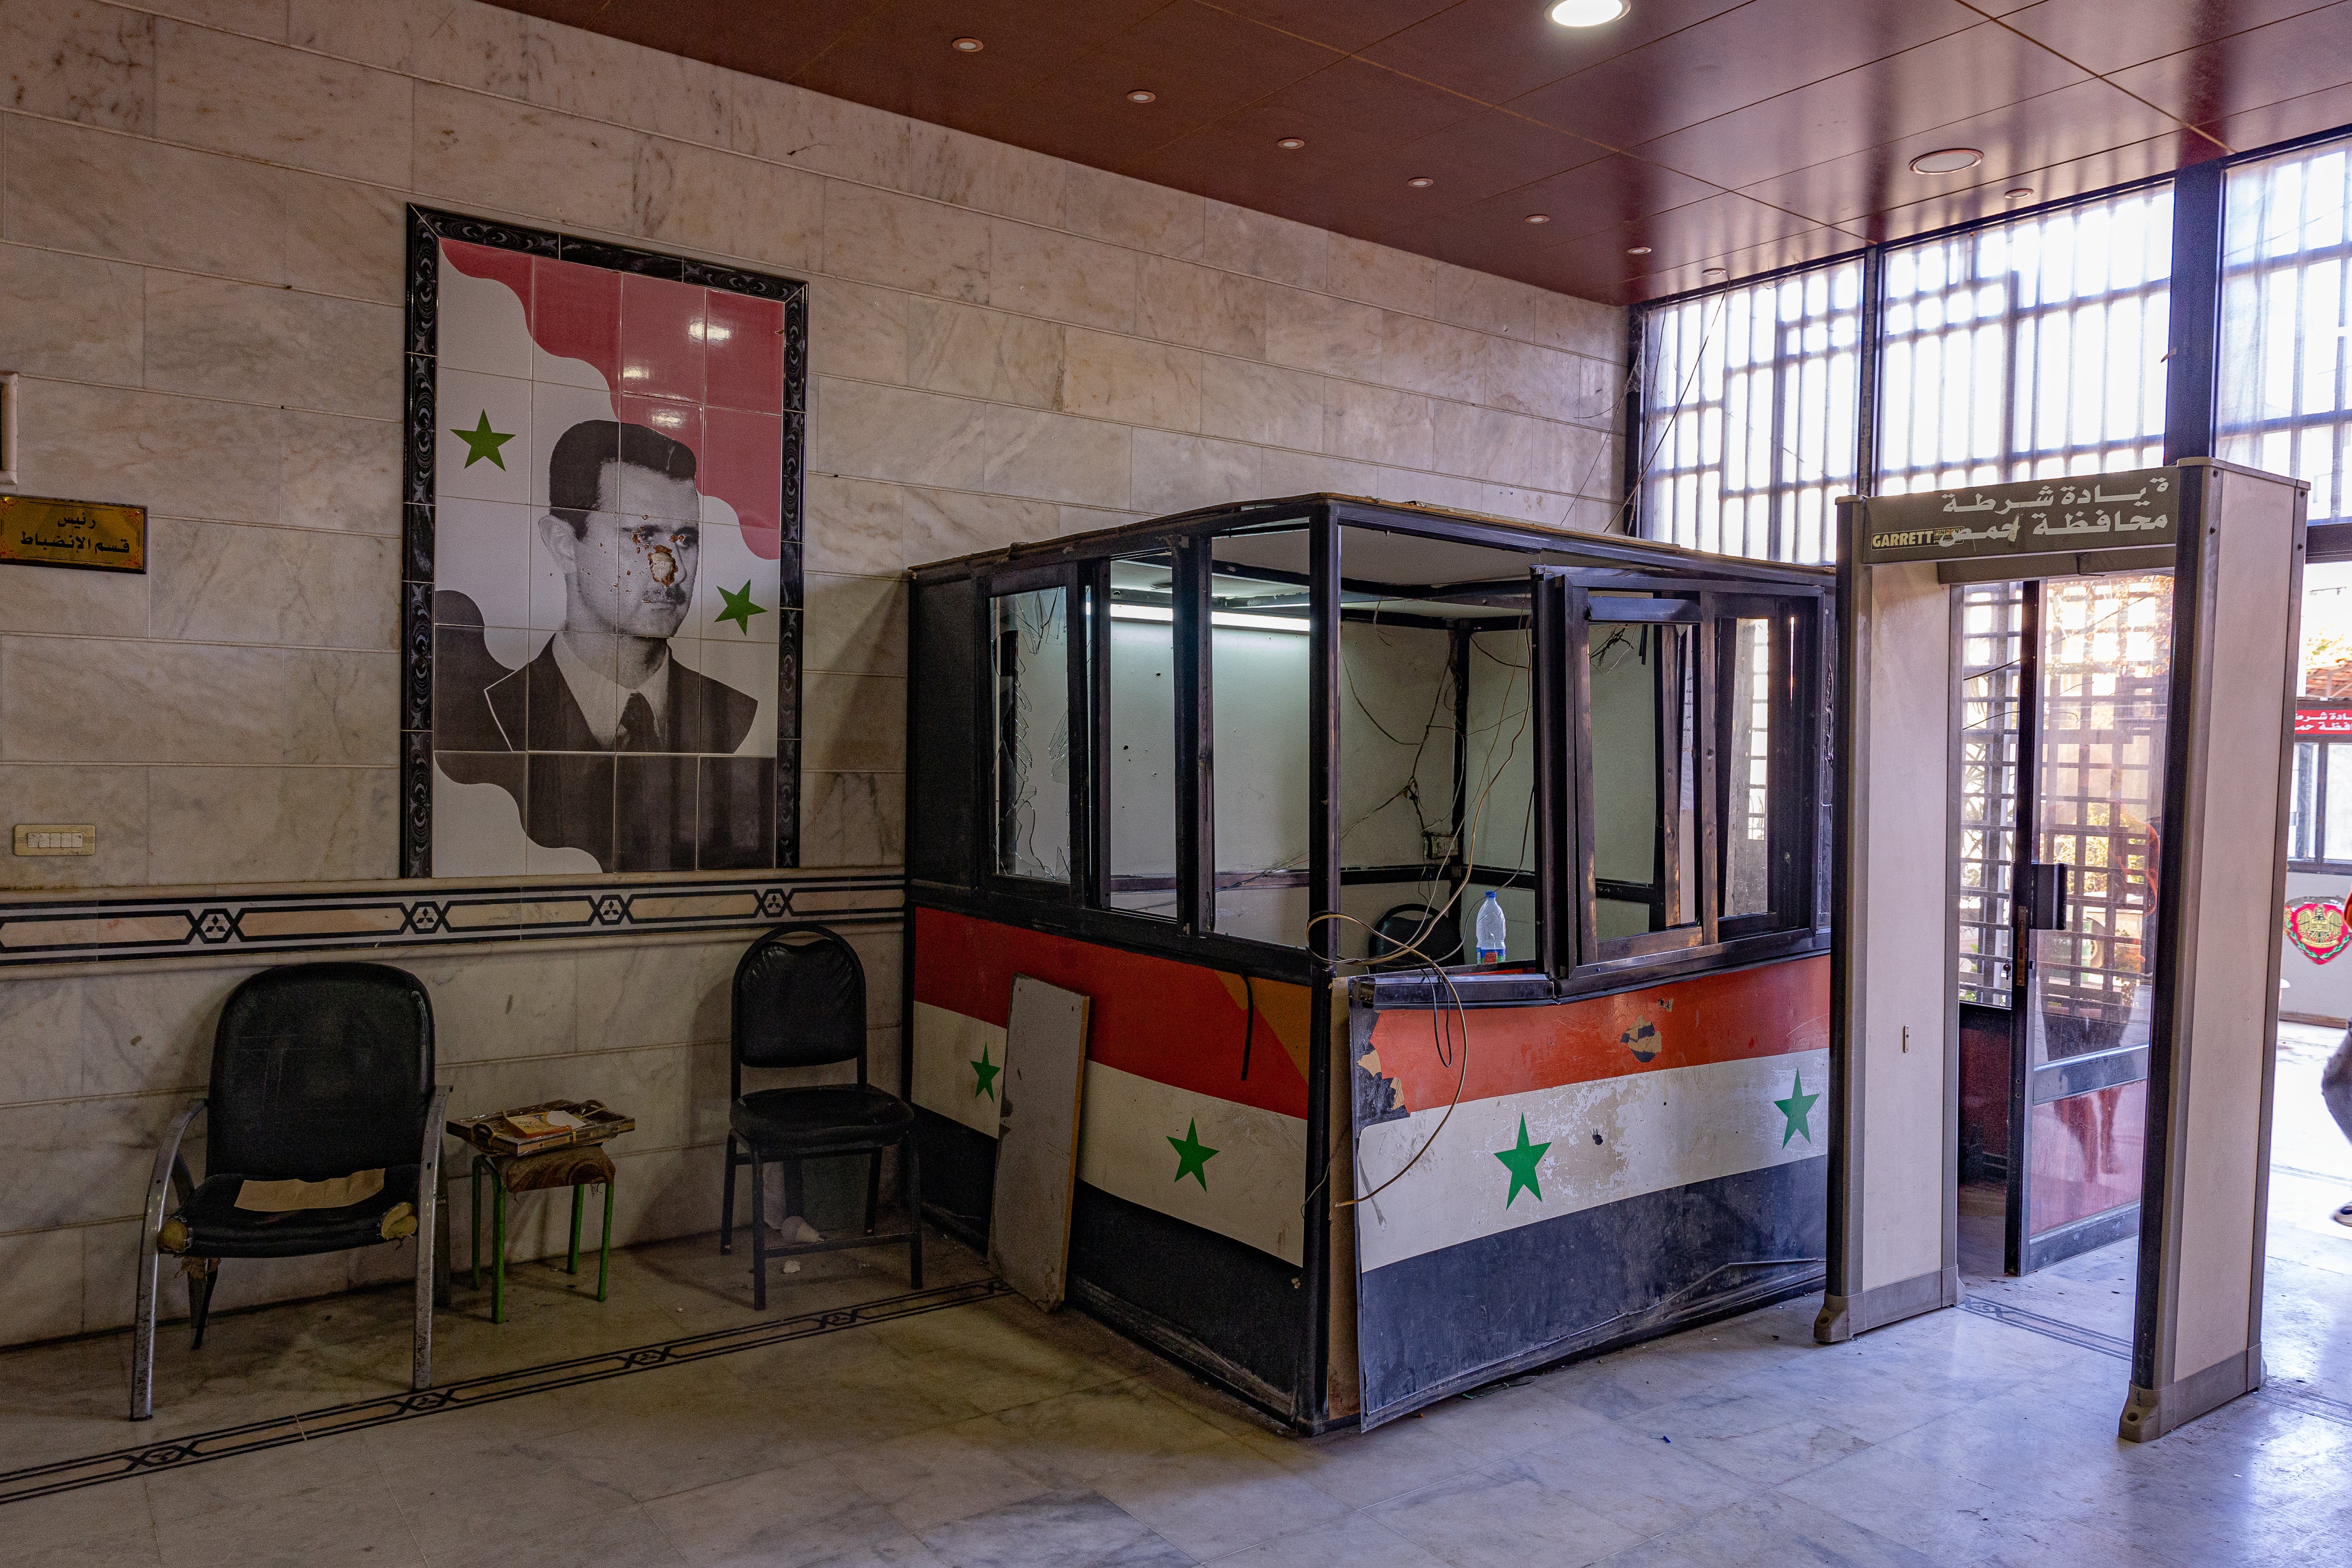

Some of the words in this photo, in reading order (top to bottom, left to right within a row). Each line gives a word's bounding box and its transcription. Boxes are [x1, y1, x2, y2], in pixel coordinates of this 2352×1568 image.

[1942, 485, 2054, 515] شرطة
[58, 511, 96, 529] رئيس
[2031, 509, 2168, 535] محافظة
[20, 531, 90, 553] الإنضباط
[95, 539, 130, 555] قسم
[1873, 531, 1933, 548] GARRETT
